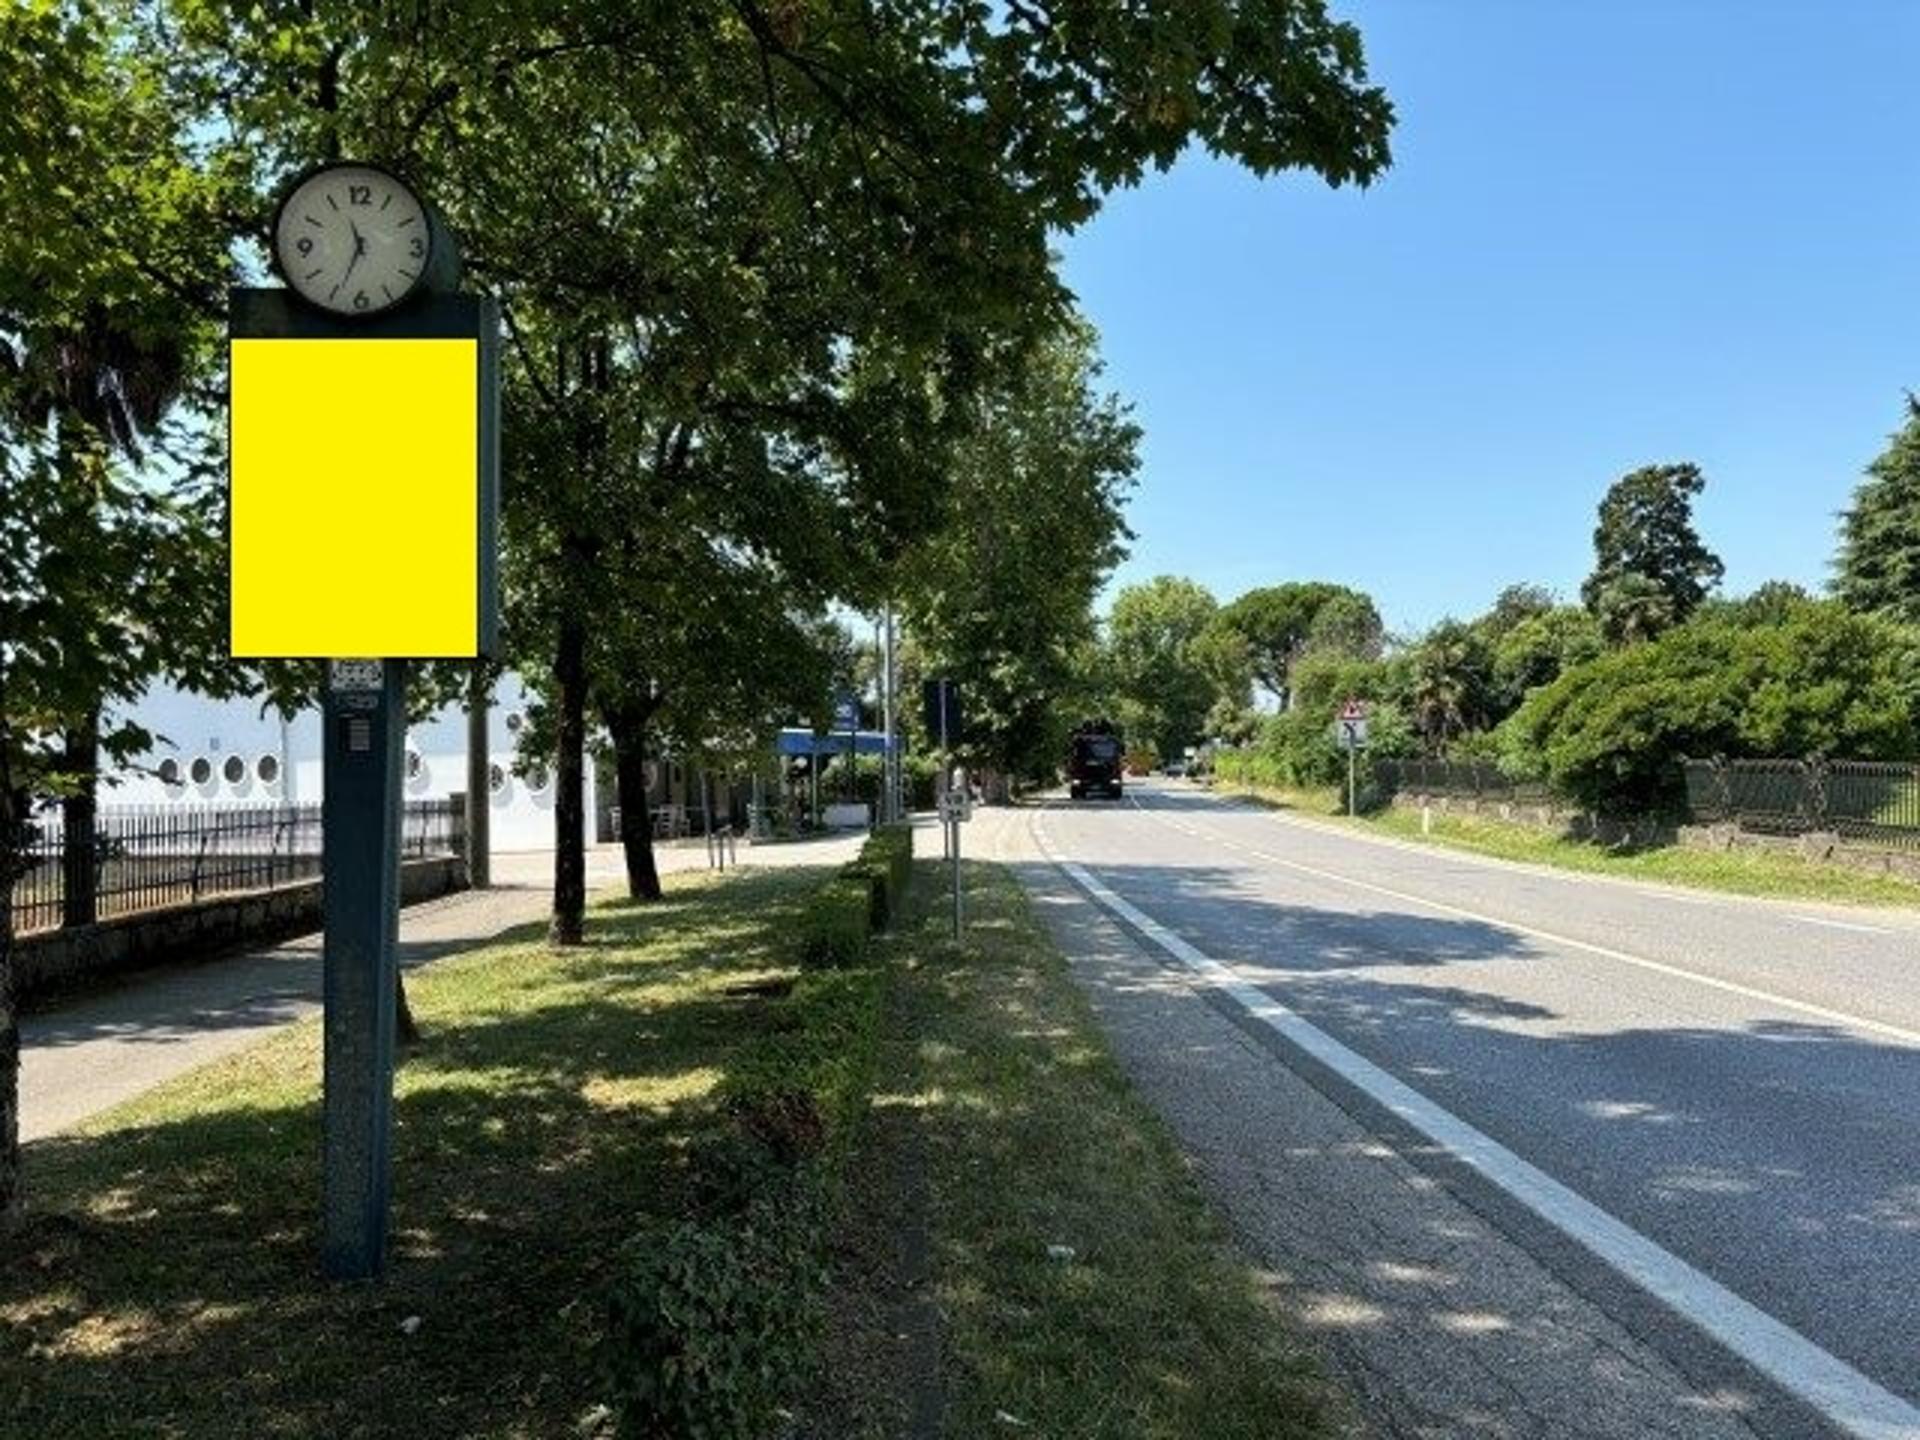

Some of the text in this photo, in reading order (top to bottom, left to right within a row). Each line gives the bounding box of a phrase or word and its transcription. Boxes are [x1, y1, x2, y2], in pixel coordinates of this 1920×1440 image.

[350, 185, 372, 205] 12
[297, 237, 313, 257] 9
[410, 238, 424, 259] 3
[354, 291, 369, 309] 6
